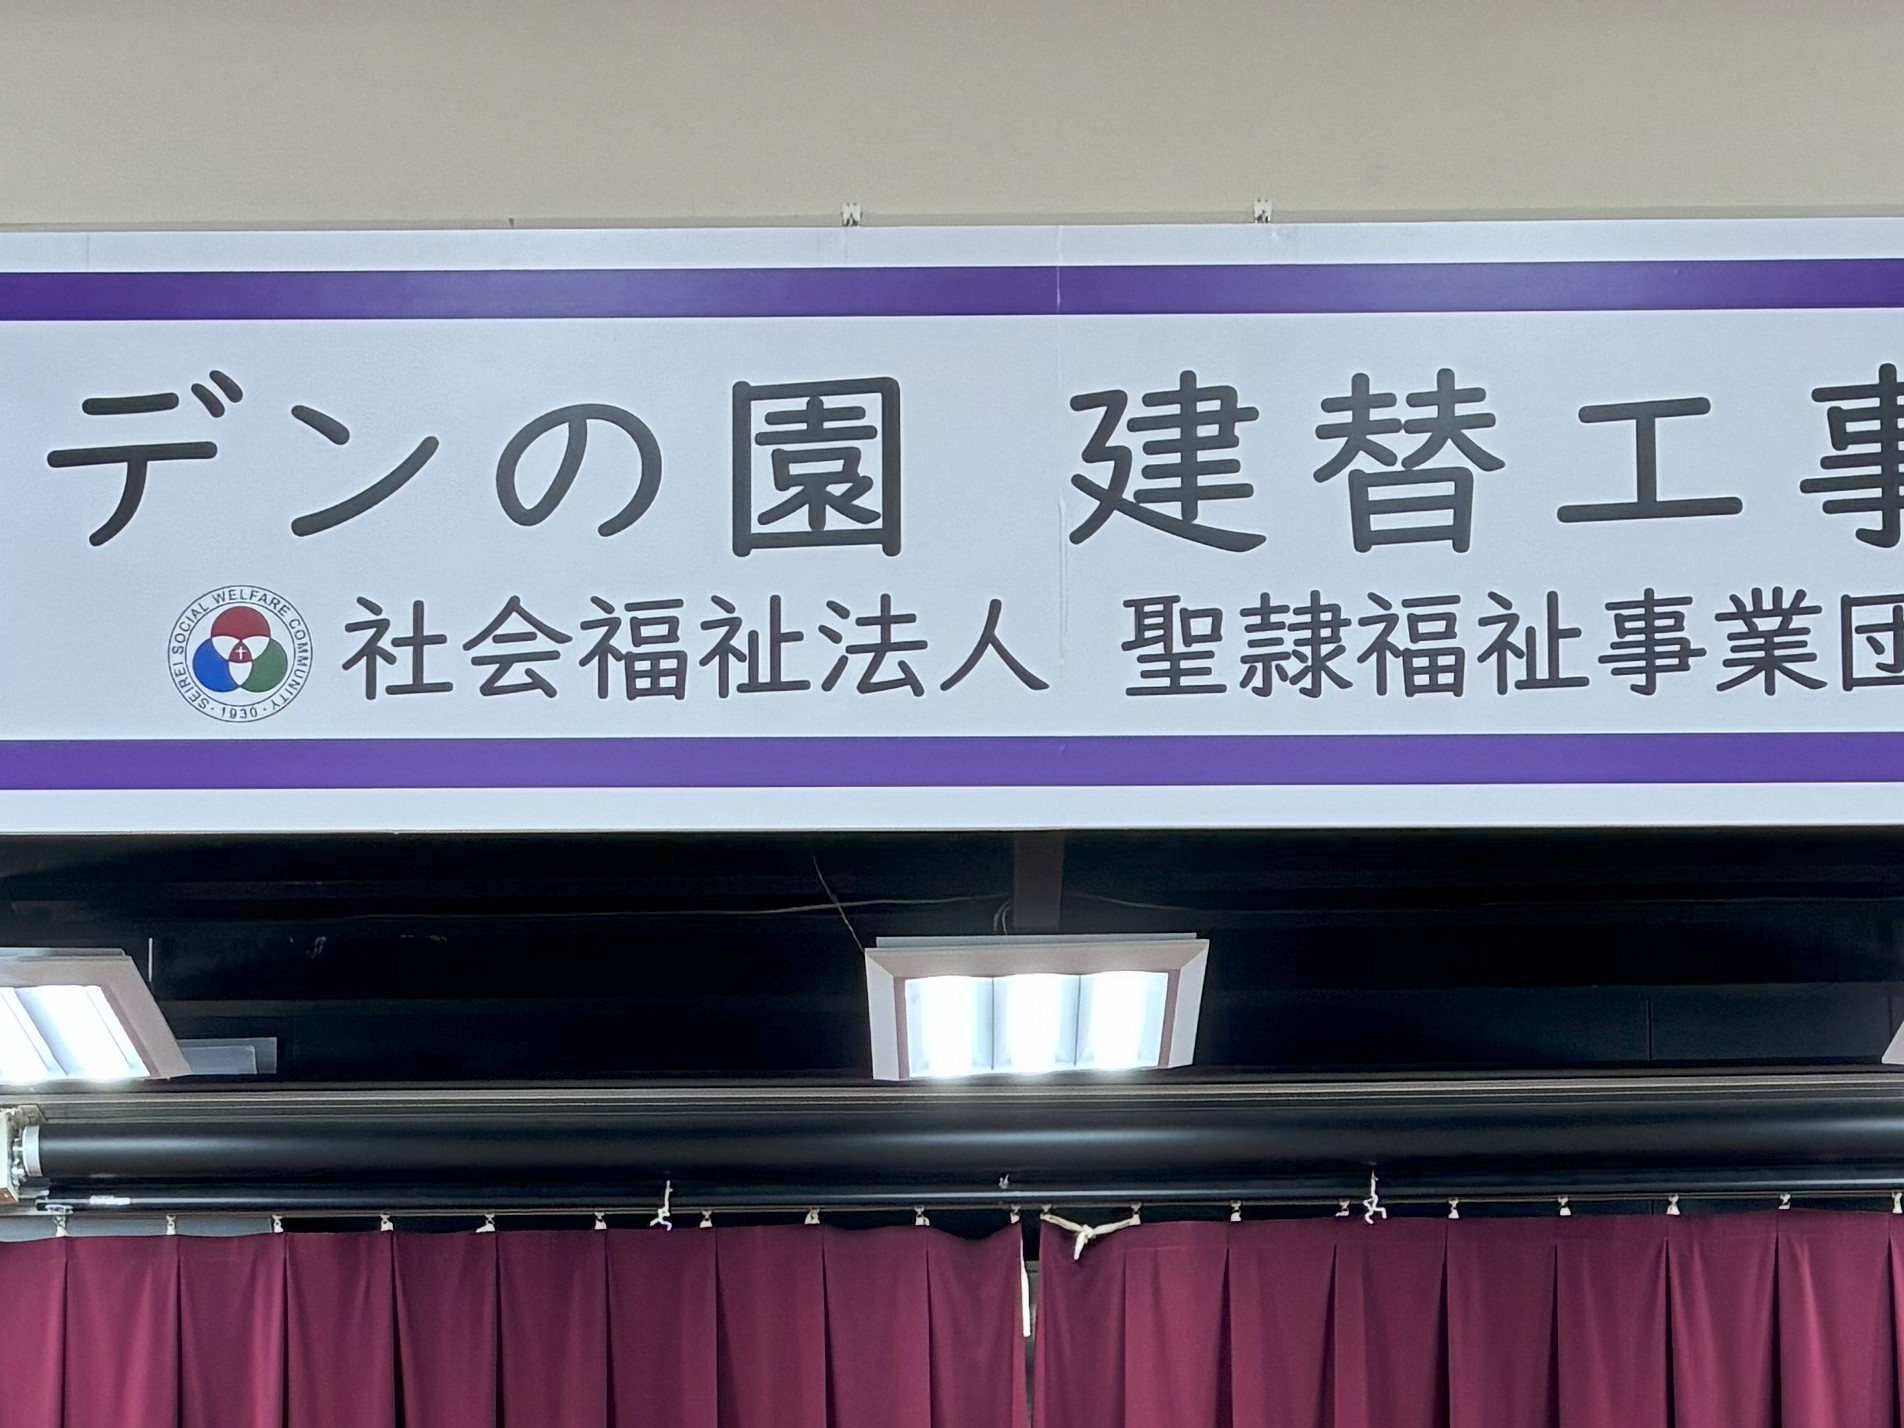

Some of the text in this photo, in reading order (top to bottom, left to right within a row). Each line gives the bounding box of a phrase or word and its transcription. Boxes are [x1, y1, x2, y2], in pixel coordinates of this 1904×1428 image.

[172, 588, 309, 711] SEIREI SOCIAL WELFARE COMMUNITY
[340, 592, 1051, 702] 社会福祉法人
